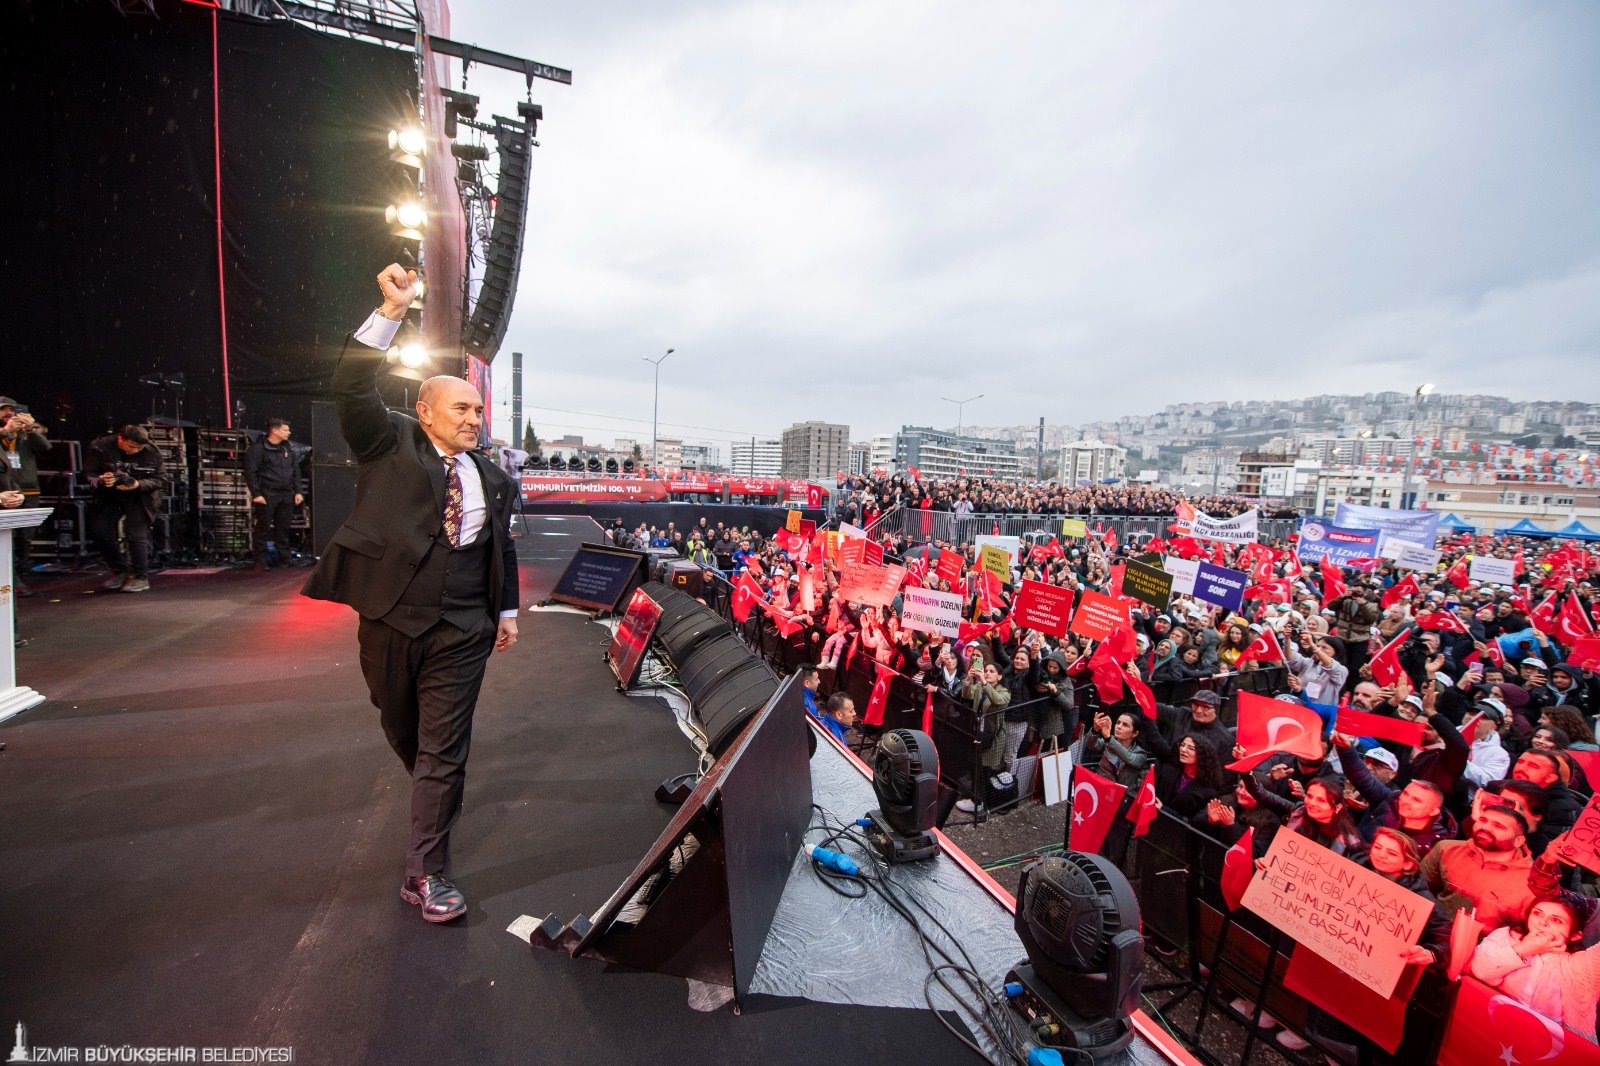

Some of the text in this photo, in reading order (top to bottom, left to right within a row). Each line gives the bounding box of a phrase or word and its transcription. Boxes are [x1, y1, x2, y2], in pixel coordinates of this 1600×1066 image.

[1261, 869, 1371, 938] HEP UMUTSUN
[1270, 854, 1318, 891] NEHİR
[1345, 897, 1412, 943] AKARSIN
[1271, 891, 1307, 919] TUNÇ
[1282, 839, 1416, 923] SUSKUN AKAN
